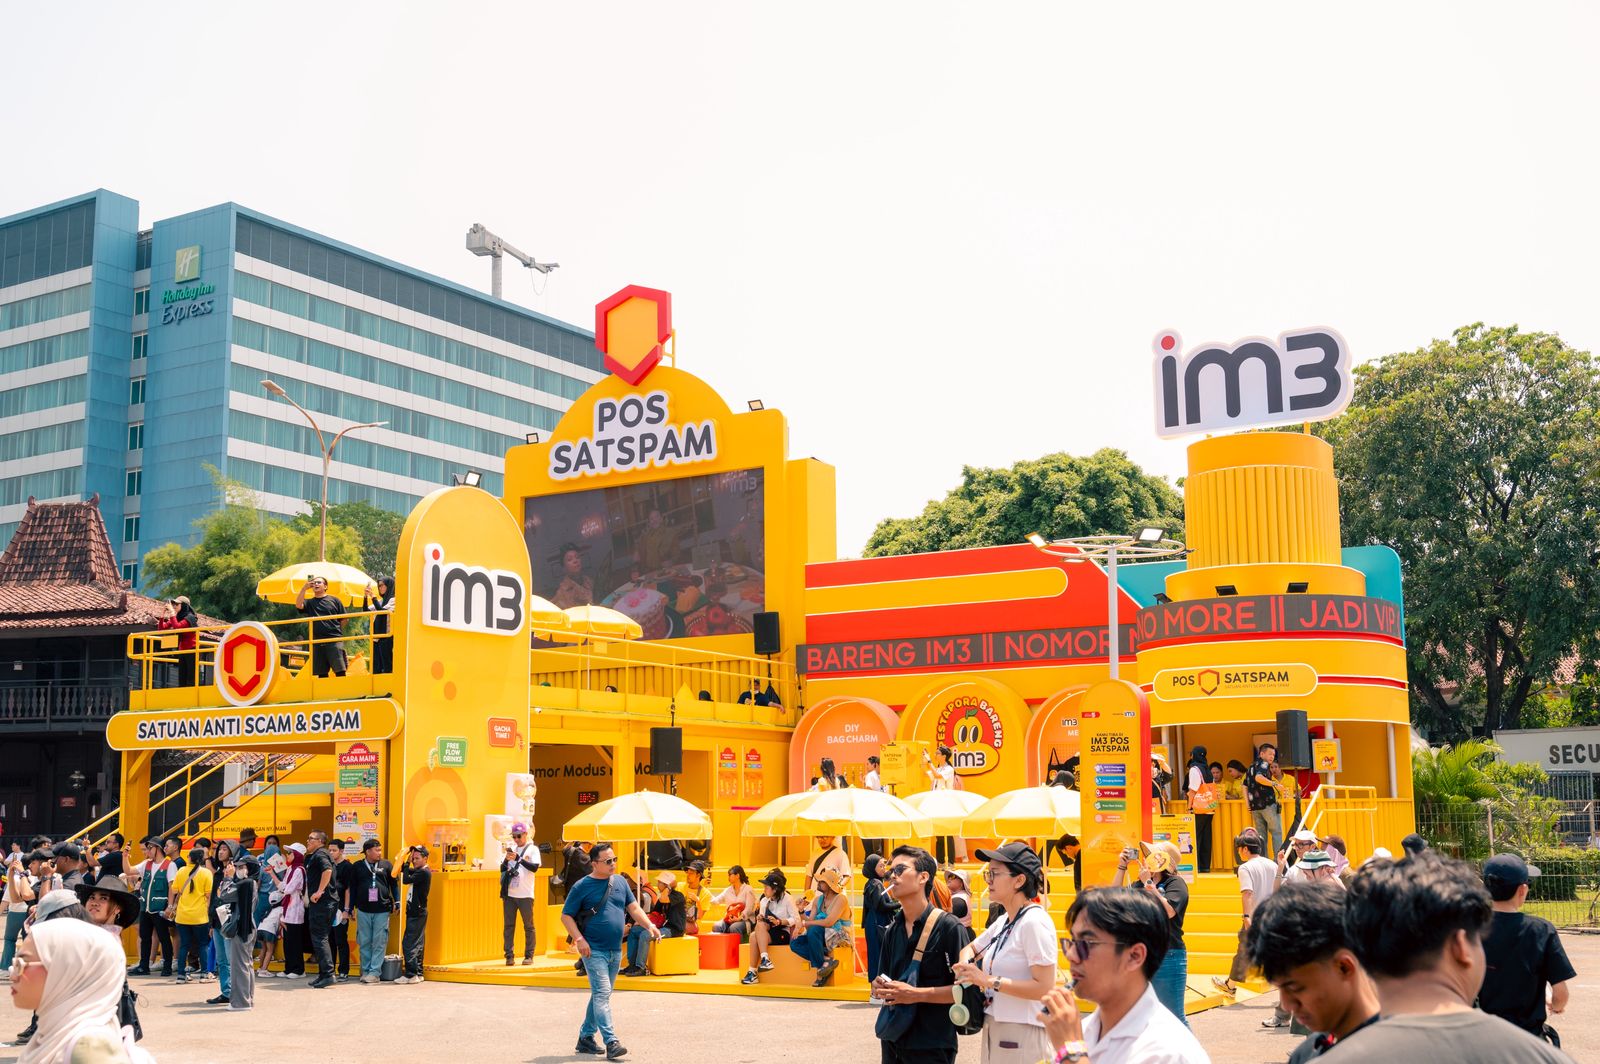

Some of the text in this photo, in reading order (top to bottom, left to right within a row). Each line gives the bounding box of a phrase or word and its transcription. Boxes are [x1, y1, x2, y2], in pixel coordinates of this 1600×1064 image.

[163, 282, 215, 304] Holiday Inn
[161, 300, 214, 325] Express
[598, 394, 665, 433] POS
[553, 424, 713, 474] SATSPAM
[1165, 602, 1256, 635] MORE
[1300, 600, 1367, 628] JADI
[1374, 603, 1395, 631] VIP
[807, 642, 916, 671] BARENG
[927, 638, 971, 664] IM3
[1172, 671, 1289, 687] POS SATSPAM
[138, 711, 360, 740] SATUAN ANTI SCAM & SPAM
[844, 723, 860, 733] DIY
[937, 697, 1003, 748] PESTAPORA BARENG
[827, 734, 878, 744] BAG CHARM
[1091, 737, 1129, 745] IM3 POS
[342, 754, 376, 763] CARA MAIN
[1549, 743, 1600, 765] SECU
[564, 763, 606, 776] Modus
